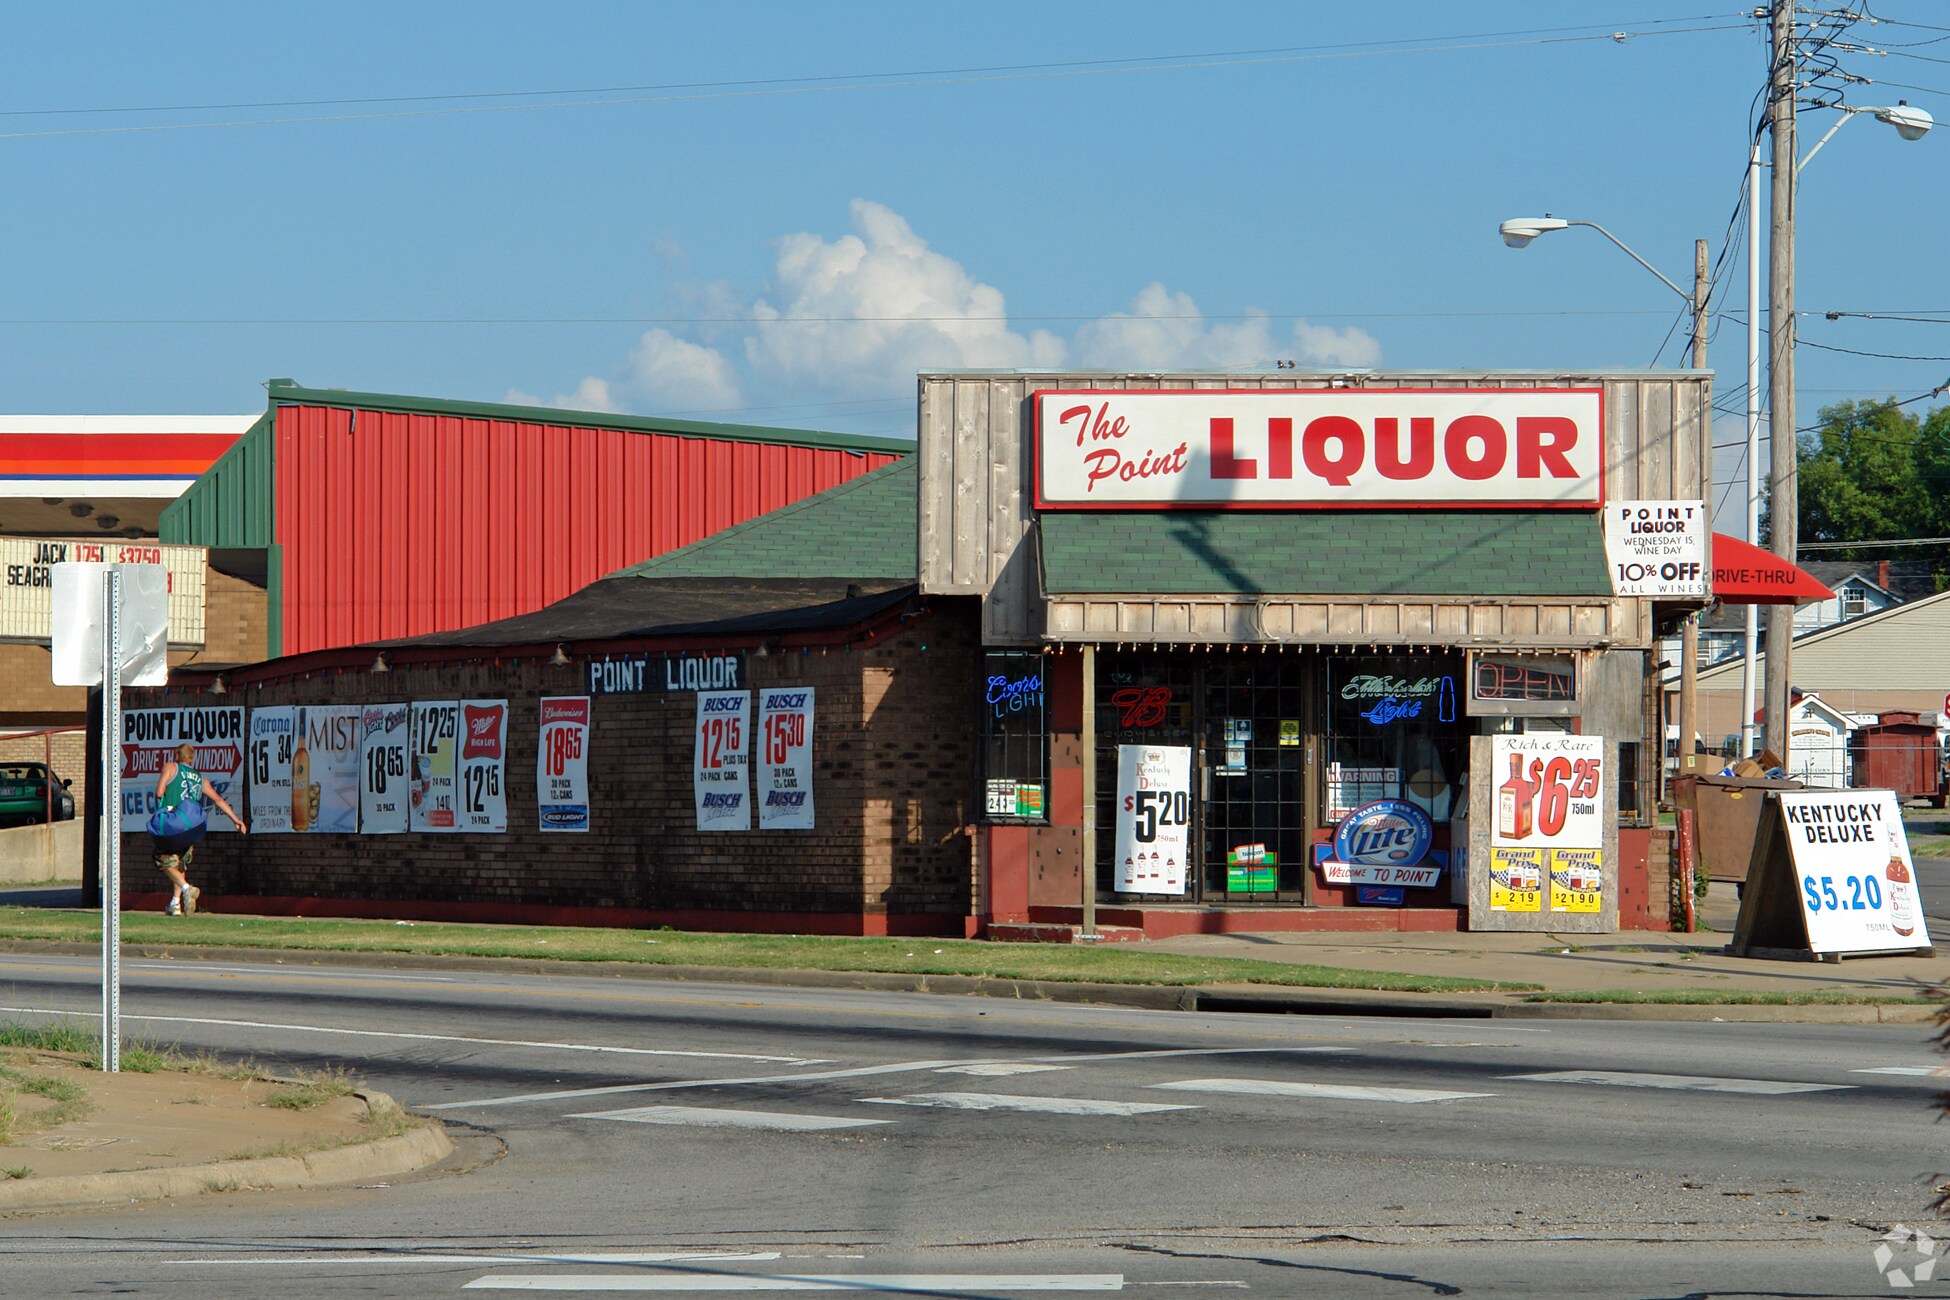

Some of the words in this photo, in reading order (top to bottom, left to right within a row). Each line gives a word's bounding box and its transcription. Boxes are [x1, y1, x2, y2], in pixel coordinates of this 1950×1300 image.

[1060, 402, 1130, 447] The
[1210, 415, 1581, 486] LIQUOR
[1084, 442, 1188, 493] Point
[1622, 508, 1694, 520] POINT
[1631, 521, 1685, 534] LIQUOR
[1623, 536, 1681, 549] WEDNESDAY
[1635, 546, 1659, 555] WINE
[1663, 546, 1682, 555] DAY
[33, 543, 67, 564] JACK
[7, 565, 53, 588] SEAGR
[1617, 563, 1657, 582] 10%
[1661, 562, 1700, 581] OFF
[1620, 585, 1645, 593] ALL
[1659, 585, 1702, 593] WINES
[591, 660, 646, 693] POINT
[667, 656, 738, 691] LIQUOR
[1478, 663, 1570, 699] OPEN
[986, 675, 1043, 704] Coors
[703, 696, 744, 712] BUSCH
[765, 694, 807, 709] BUSCH
[996, 691, 1045, 718] LIGHT
[545, 706, 584, 719] Budweiser
[1361, 696, 1422, 724] Light
[124, 711, 176, 741] POINT
[179, 709, 241, 743] LIQUOR
[254, 716, 290, 736] Corona
[309, 716, 359, 751] MIST
[471, 739, 484, 747] HIGH
[485, 739, 495, 747] LIFE
[1501, 738, 1538, 750] Rich
[1542, 741, 1551, 750] &
[1554, 739, 1593, 751] Rare
[132, 750, 160, 771] DRIVE
[194, 748, 235, 771] WINDOW
[723, 755, 736, 765] PLUS
[737, 754, 747, 764] TAX
[701, 772, 707, 781] 24
[708, 771, 721, 781] PACK
[724, 771, 738, 780] CANS
[774, 768, 781, 777] 30
[782, 768, 795, 777] PACK
[439, 778, 451, 786] PACK
[559, 779, 571, 788] PACK
[784, 778, 797, 788] CANS
[121, 792, 143, 815] ICE
[702, 792, 743, 808] BUSCH
[765, 790, 807, 806] BUSCH
[383, 803, 395, 812] PACK
[1572, 803, 1595, 815] 750ml
[1787, 804, 1882, 823] KENTUCKY
[478, 816, 490, 824] PACK
[1351, 826, 1415, 856] Lite
[1805, 824, 1875, 843] DELUXE
[1496, 850, 1535, 859] Grand
[1556, 851, 1596, 860] Grand
[1329, 866, 1367, 878] WELCOME
[1374, 868, 1390, 881] TO
[1394, 869, 1434, 883] POINT
[1804, 875, 1882, 915] $5.20
